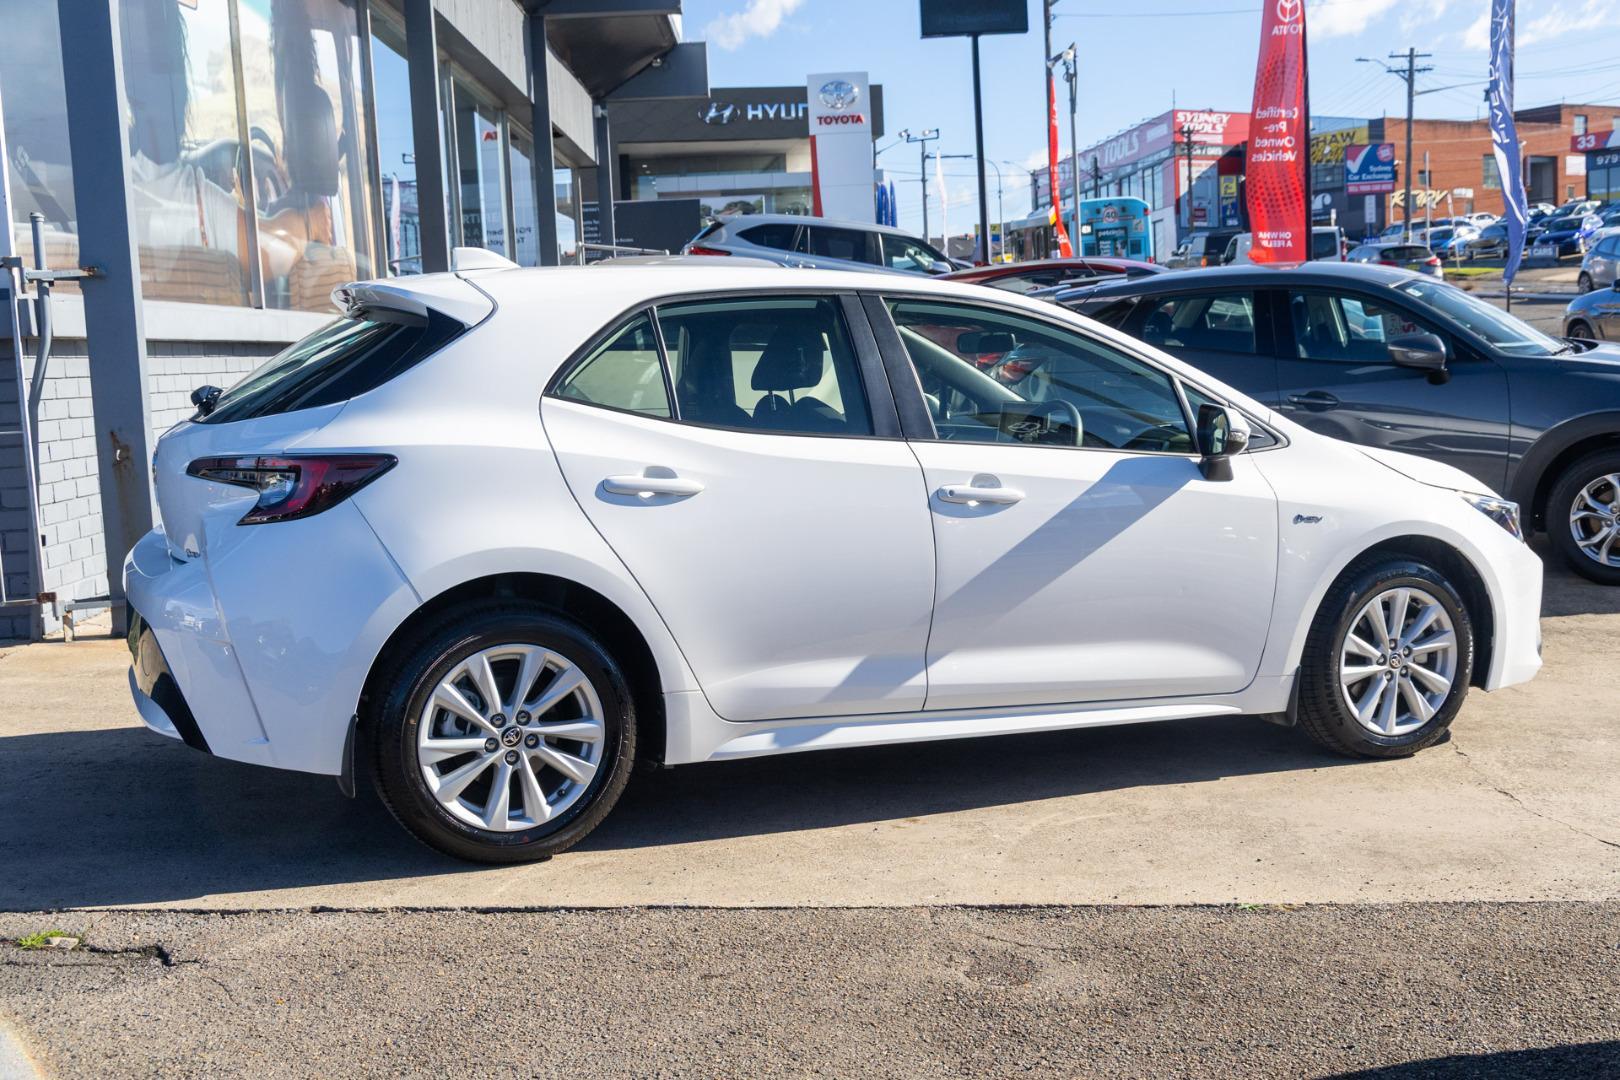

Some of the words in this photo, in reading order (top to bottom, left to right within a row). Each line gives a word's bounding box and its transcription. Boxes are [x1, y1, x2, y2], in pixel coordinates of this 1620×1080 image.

[817, 114, 865, 126] TOYOTA
[1175, 112, 1232, 124] SYDNEY
[1490, 89, 1510, 144] FIVE
[1104, 131, 1139, 166] TOOLS
[1576, 134, 1596, 149] 33
